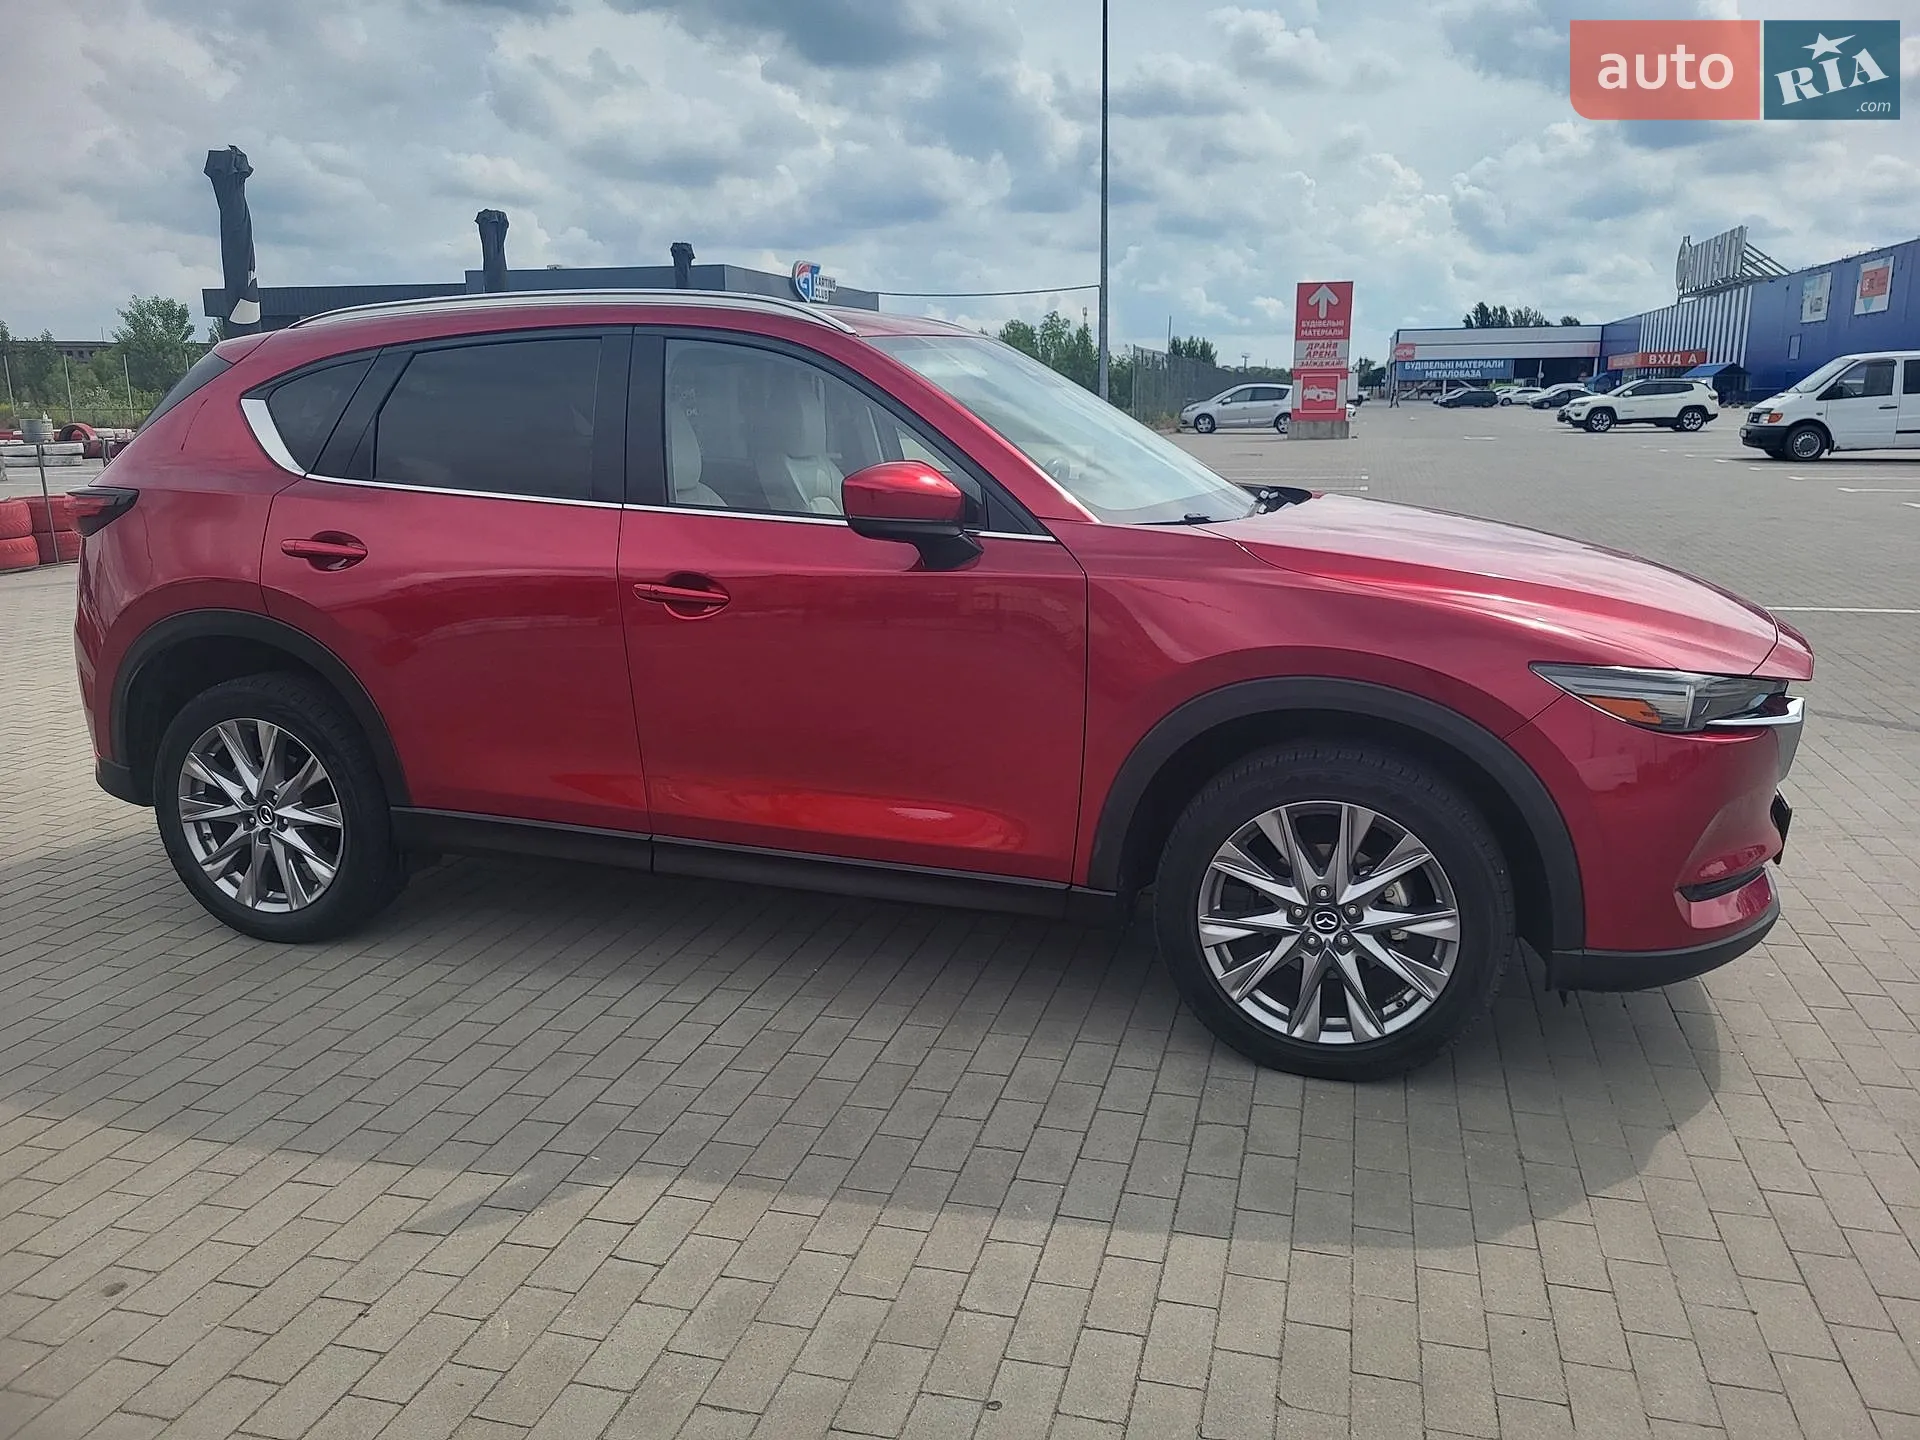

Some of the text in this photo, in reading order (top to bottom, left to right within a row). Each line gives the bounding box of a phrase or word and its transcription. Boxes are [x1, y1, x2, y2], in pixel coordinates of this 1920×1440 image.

[815, 287, 828, 300] CLUB
[1300, 328, 1344, 337] МАТЕРІАЛИ
[1305, 341, 1338, 350] ДРАЙВ
[1305, 350, 1338, 359] АРЕНА
[1648, 354, 1681, 365] ВХІД
[1404, 359, 1504, 370] БУДІВЕЛЬНІ МАТЕРІАЛИ
[1424, 369, 1482, 379] МЕТАЛОБАЗА
